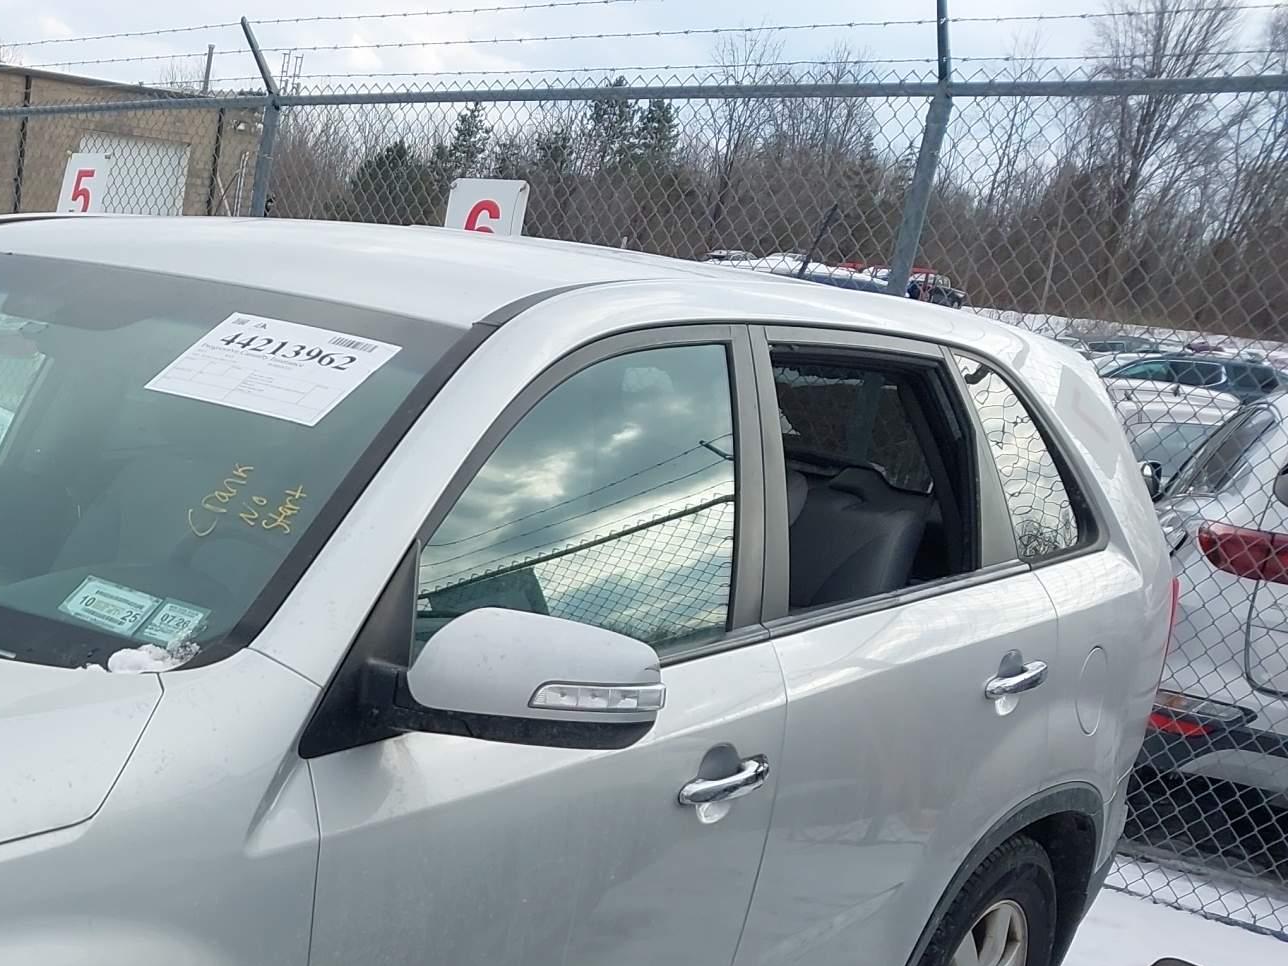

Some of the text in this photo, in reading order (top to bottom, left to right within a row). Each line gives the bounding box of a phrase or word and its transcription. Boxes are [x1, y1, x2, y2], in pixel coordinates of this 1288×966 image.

[71, 169, 96, 213] 5
[220, 332, 357, 371] 44213962
[79, 594, 96, 607] 10
[120, 610, 141, 623] 25
